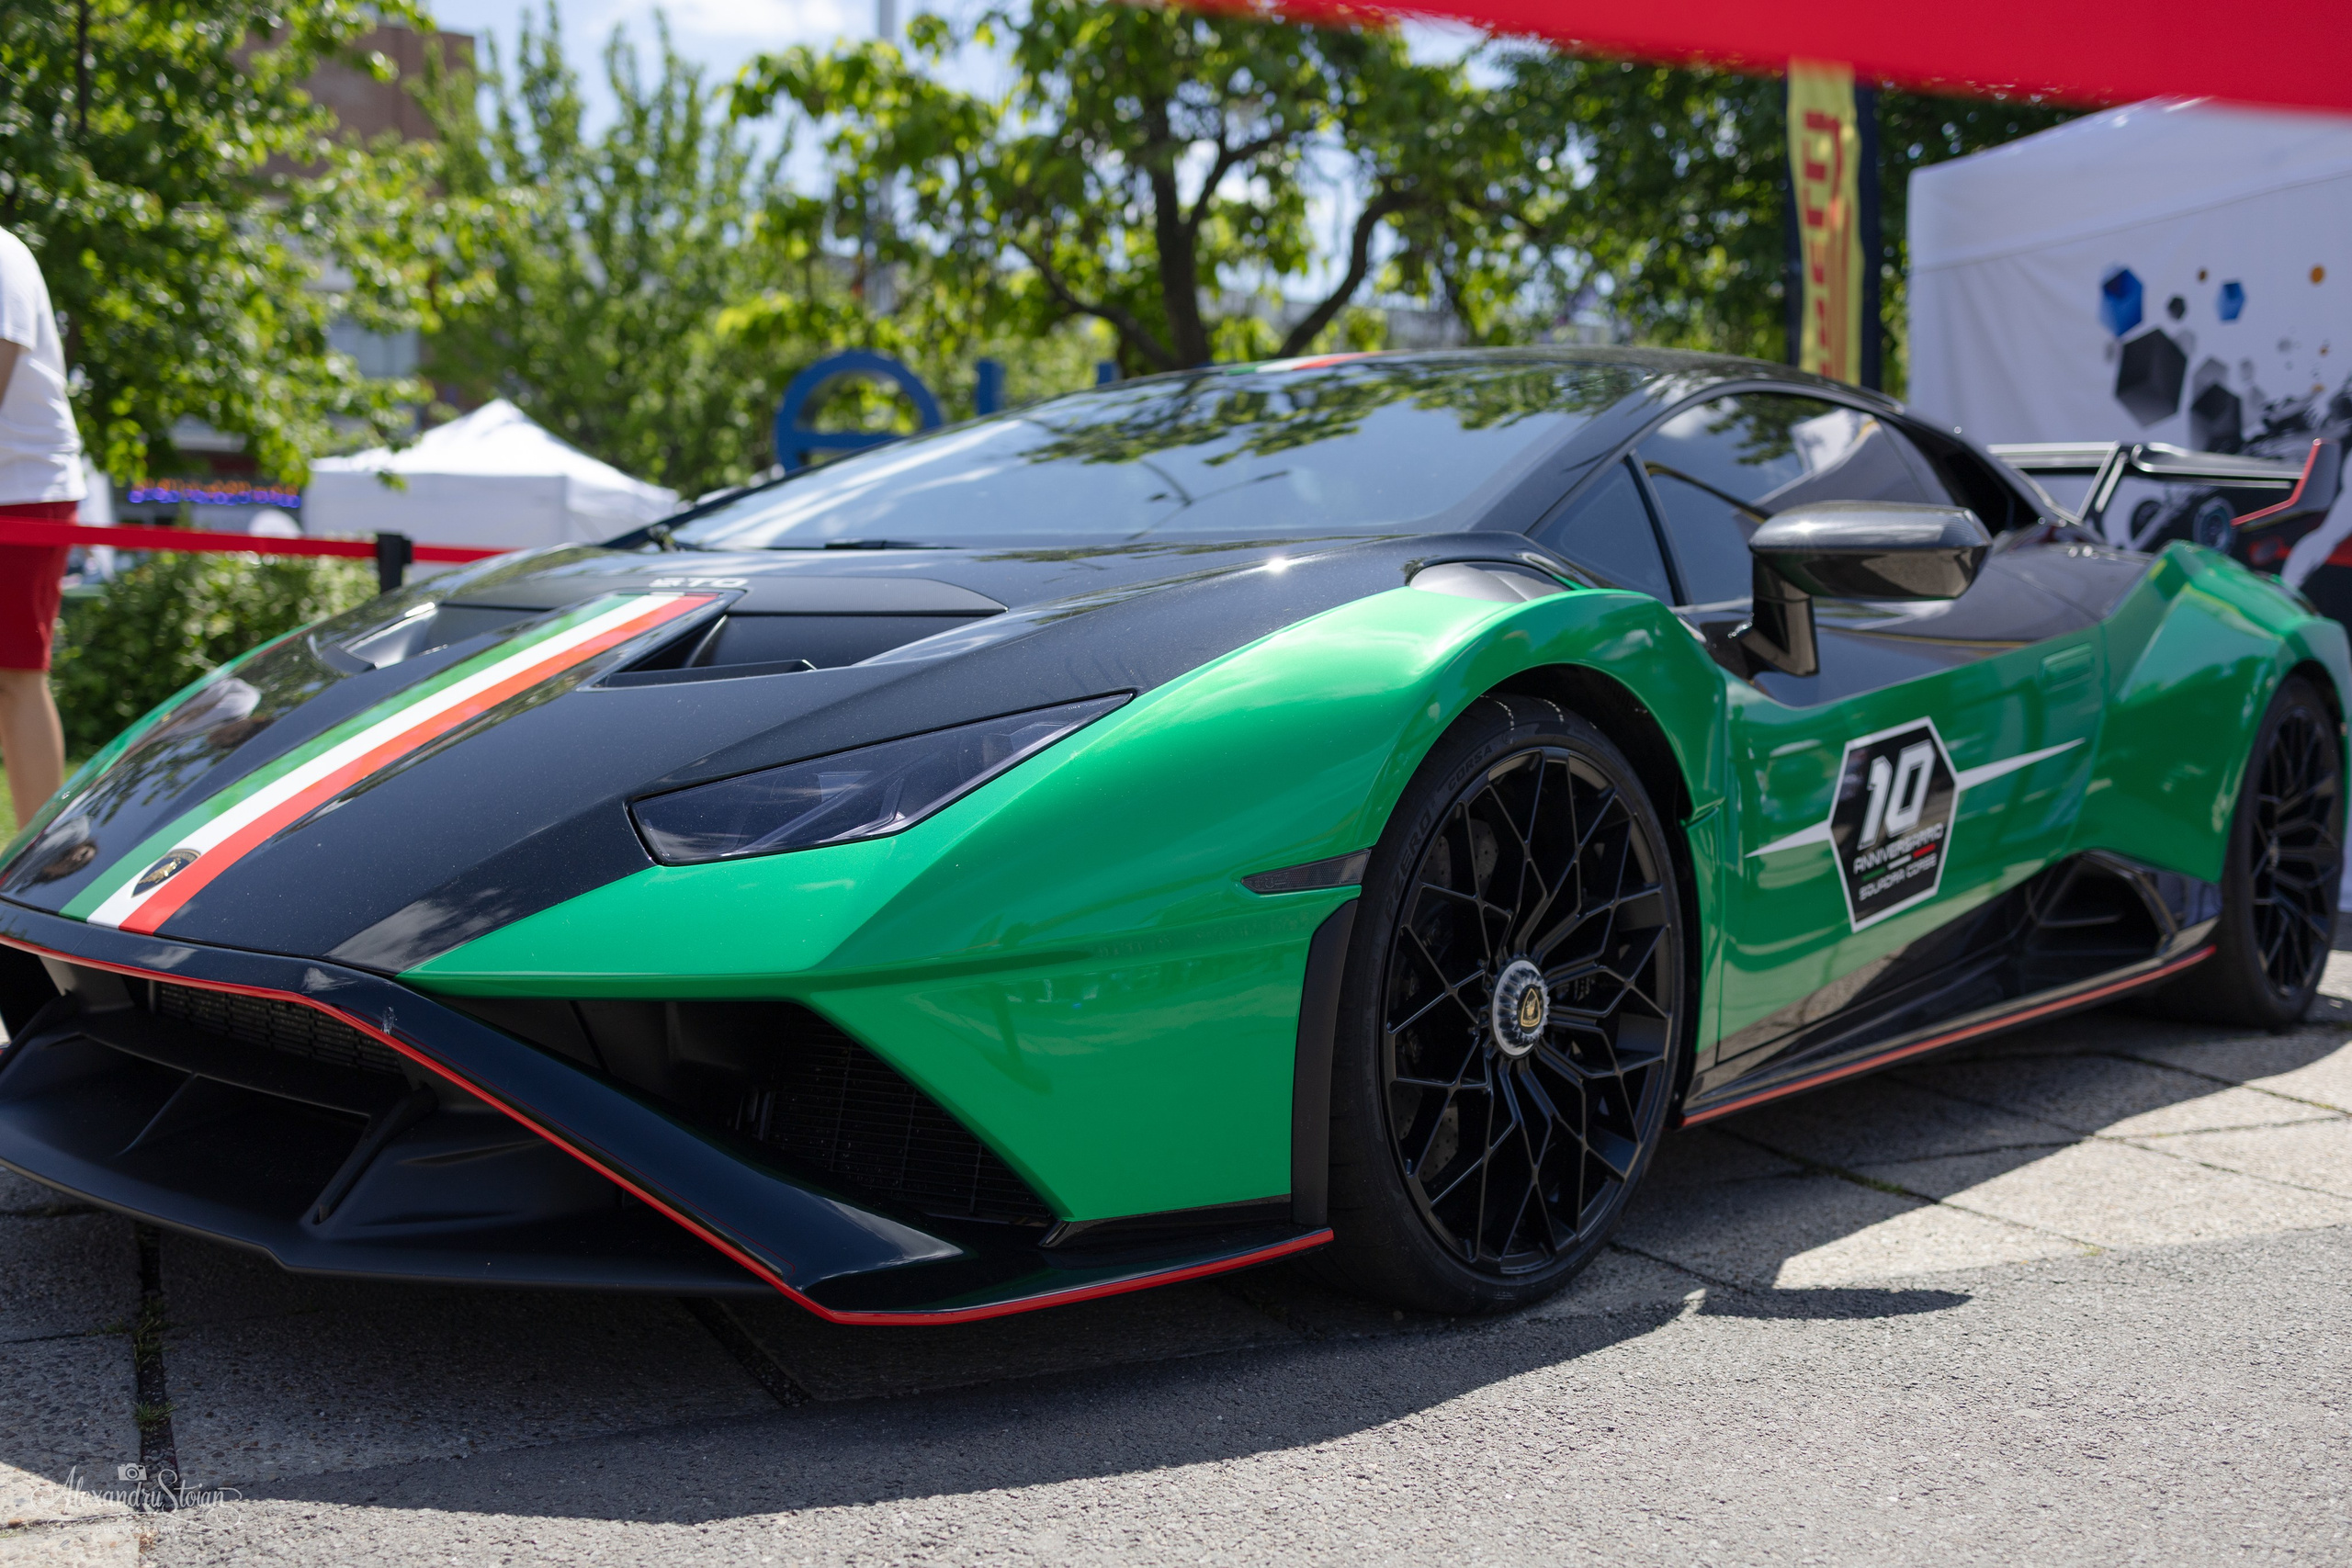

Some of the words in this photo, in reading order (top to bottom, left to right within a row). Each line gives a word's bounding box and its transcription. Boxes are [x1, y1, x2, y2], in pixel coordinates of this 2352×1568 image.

[1447, 744, 1494, 792] CORSA
[1858, 739, 1937, 851] 10
[1859, 867, 1905, 901] SQUADRA
[1905, 852, 1938, 879] CORSE
